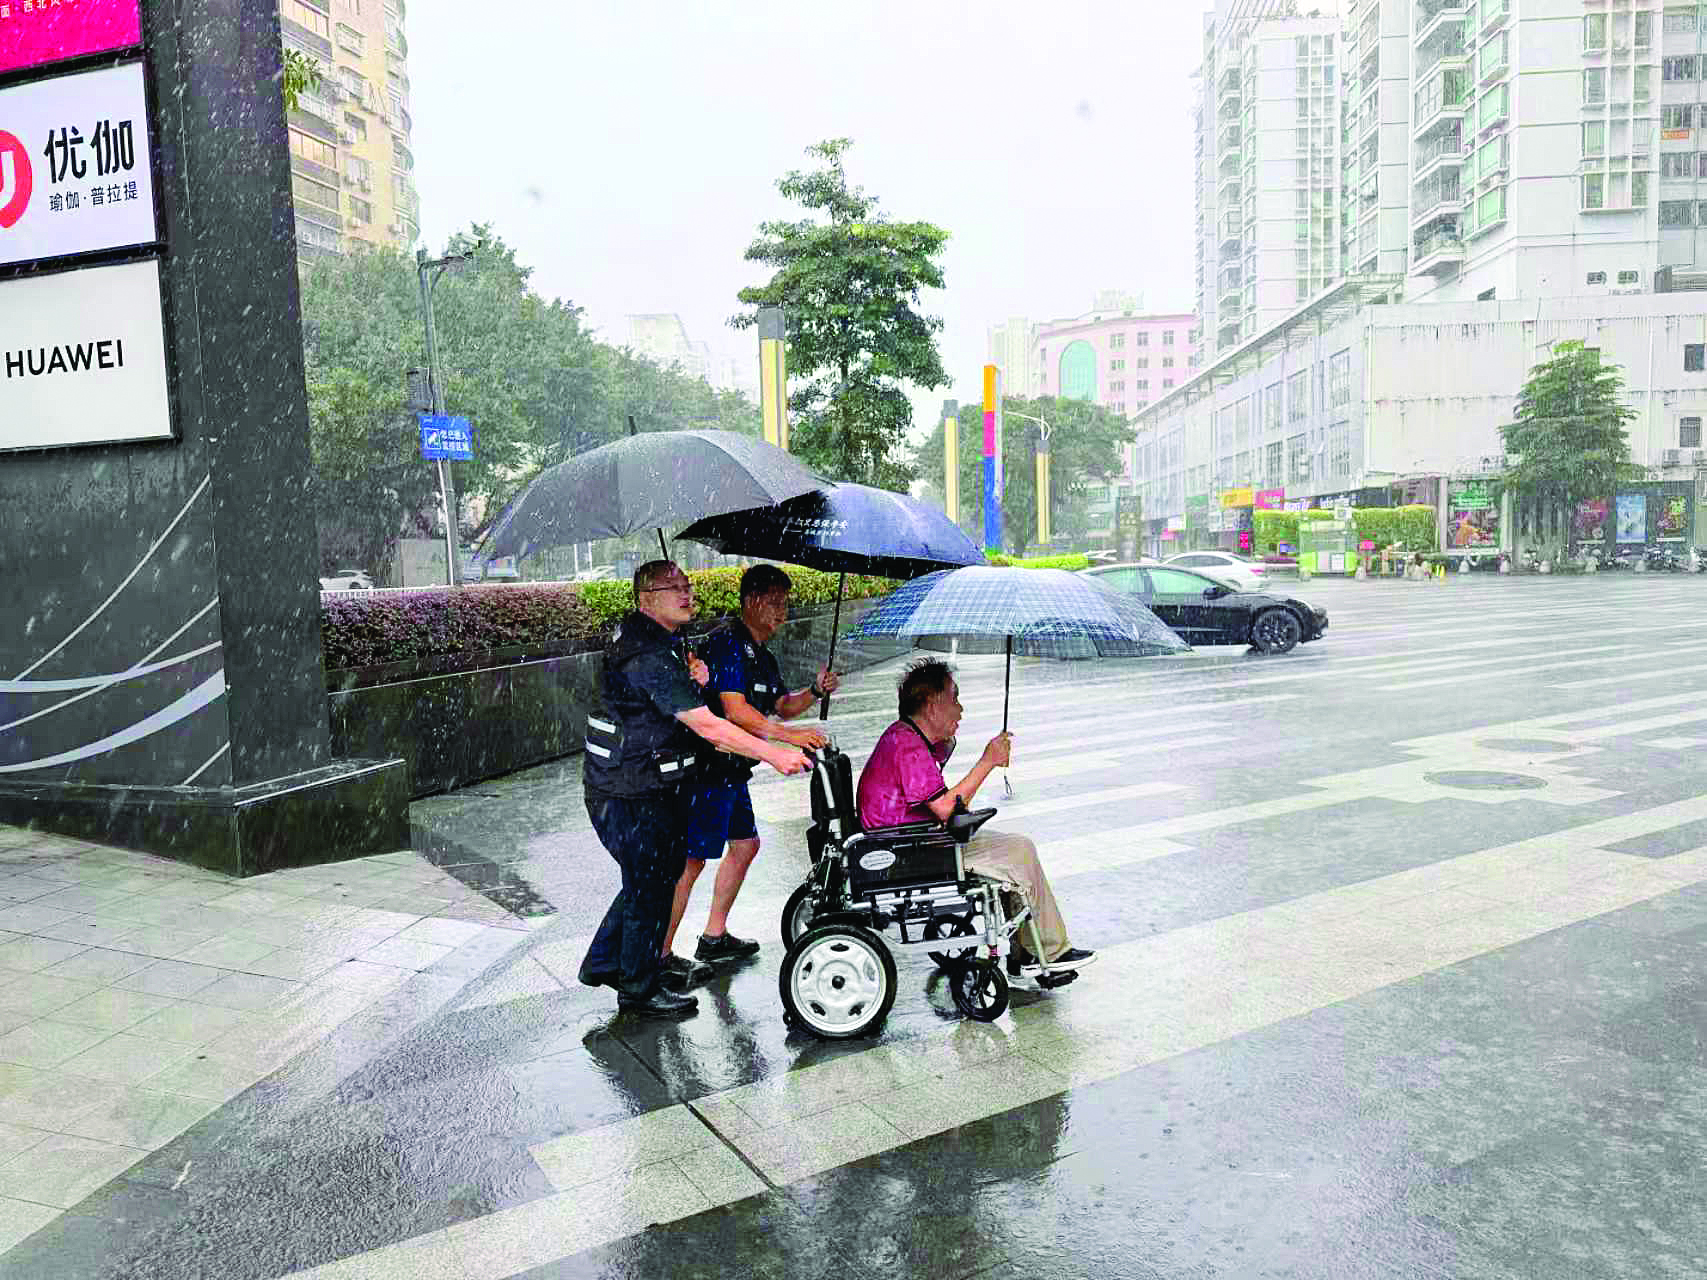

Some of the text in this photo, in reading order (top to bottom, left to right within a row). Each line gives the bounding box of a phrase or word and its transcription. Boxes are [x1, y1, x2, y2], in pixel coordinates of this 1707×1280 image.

[44, 120, 134, 184] 优伽
[49, 181, 138, 212] 瑜伽·普拉提
[5, 339, 124, 378] HUAWEI
